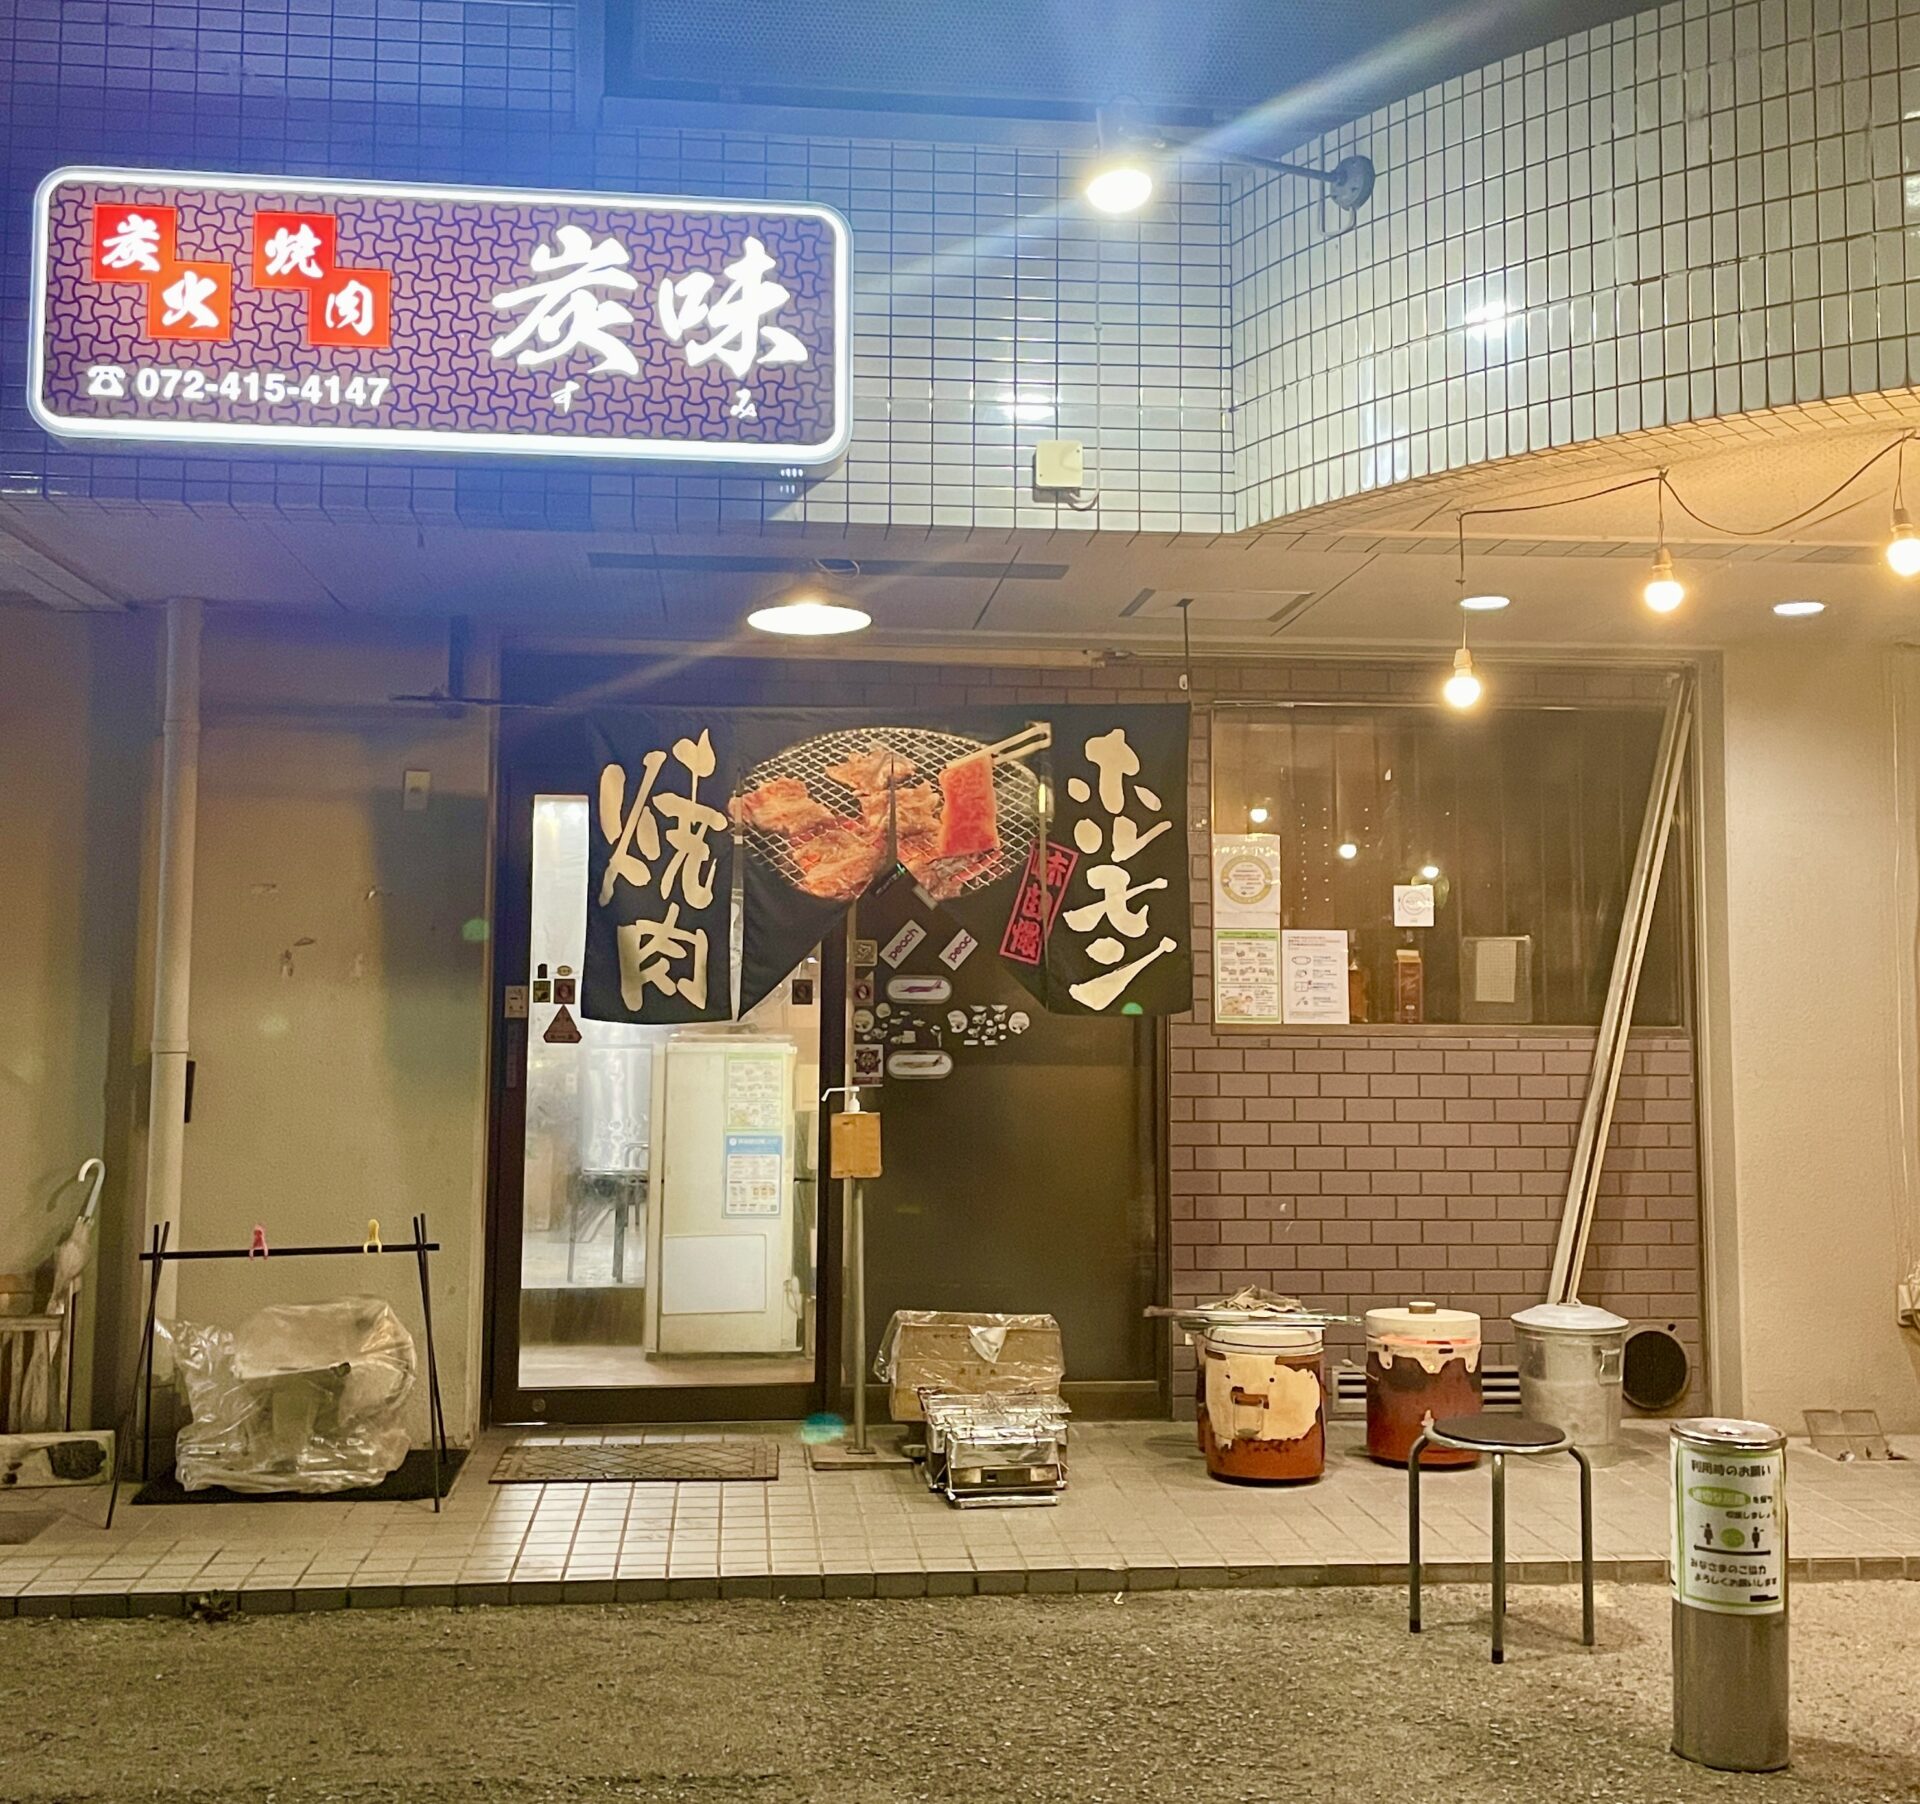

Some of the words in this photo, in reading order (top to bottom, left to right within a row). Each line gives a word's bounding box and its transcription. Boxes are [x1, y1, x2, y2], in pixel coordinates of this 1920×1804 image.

[101, 213, 220, 329] 炭火
[264, 223, 374, 336] 焼肉
[491, 225, 808, 378] 炭味
[137, 367, 390, 407] 072-415-4147
[599, 728, 728, 1011] 焼肉
[1063, 728, 1178, 1011] ホルモン
[887, 927, 919, 961] peach
